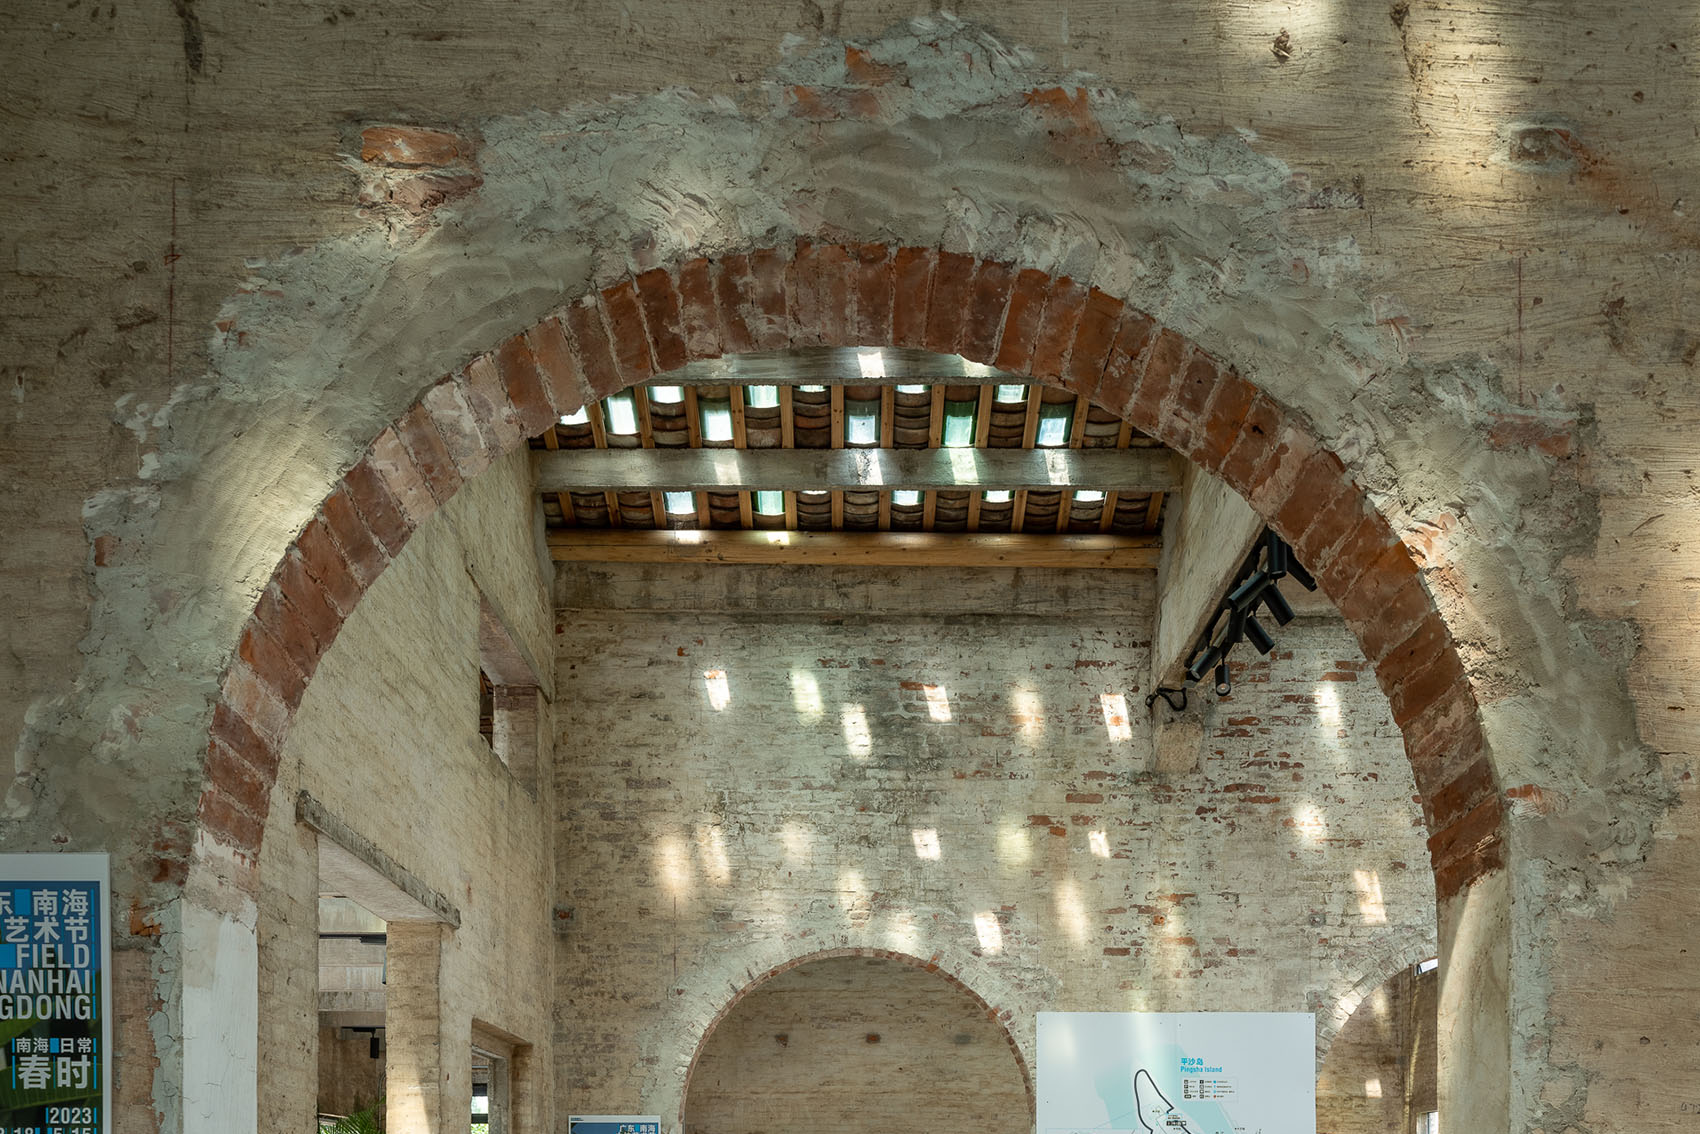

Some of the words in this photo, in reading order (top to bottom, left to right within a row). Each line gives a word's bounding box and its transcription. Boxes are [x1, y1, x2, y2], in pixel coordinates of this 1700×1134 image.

[32, 889, 89, 916] 南海
[3, 916, 90, 944] 艺术节
[16, 943, 90, 969] FIELD
[16, 1037, 49, 1054] 南海
[60, 1037, 92, 1054] 日常
[17, 1054, 92, 1090] 春时
[1180, 1057, 1204, 1066] 平沙岛
[49, 1107, 92, 1125] 2023
